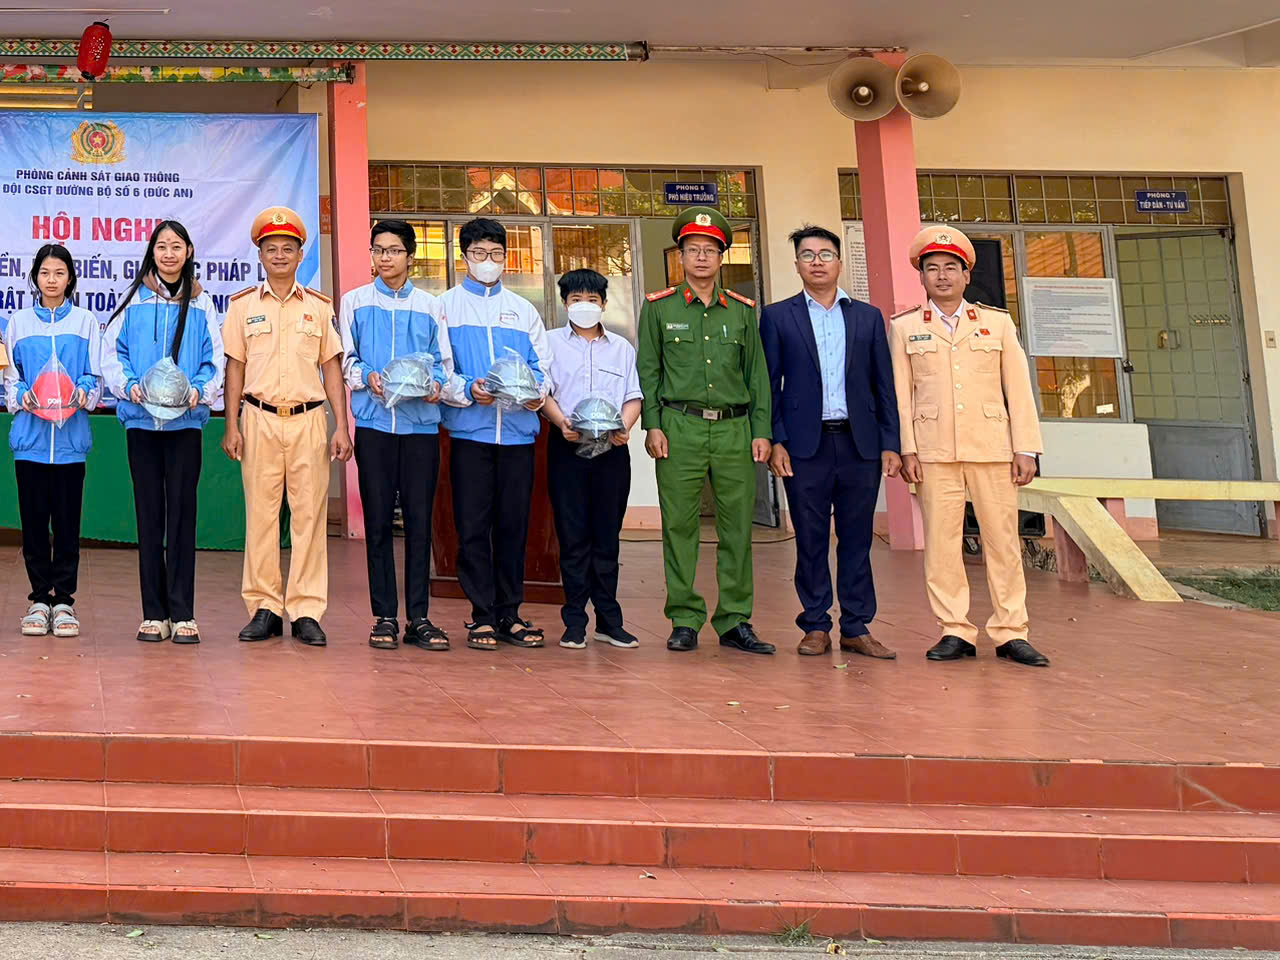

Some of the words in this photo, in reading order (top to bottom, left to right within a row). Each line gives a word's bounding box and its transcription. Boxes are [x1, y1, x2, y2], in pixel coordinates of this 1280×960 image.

[16, 168, 54, 180] PHÒNG
[57, 167, 87, 181] CẢNH
[90, 170, 111, 182] SÁT
[114, 172, 140, 182] GIAO
[143, 171, 180, 183] THÔNG
[2, 182, 21, 195] ĐỘI
[24, 184, 53, 195] CSGT
[56, 184, 94, 196] ĐƯỜNG
[97, 185, 112, 199] BỘ
[115, 184, 131, 197] SỐ
[133, 187, 140, 197] 6
[143, 185, 170, 199] (ĐỨC
[173, 187, 193, 199] AN)
[32, 210, 81, 246] HỘI
[91, 217, 163, 243] NGH
[207, 258, 252, 282] PHÁP
[85, 288, 122, 312] TOÀ
